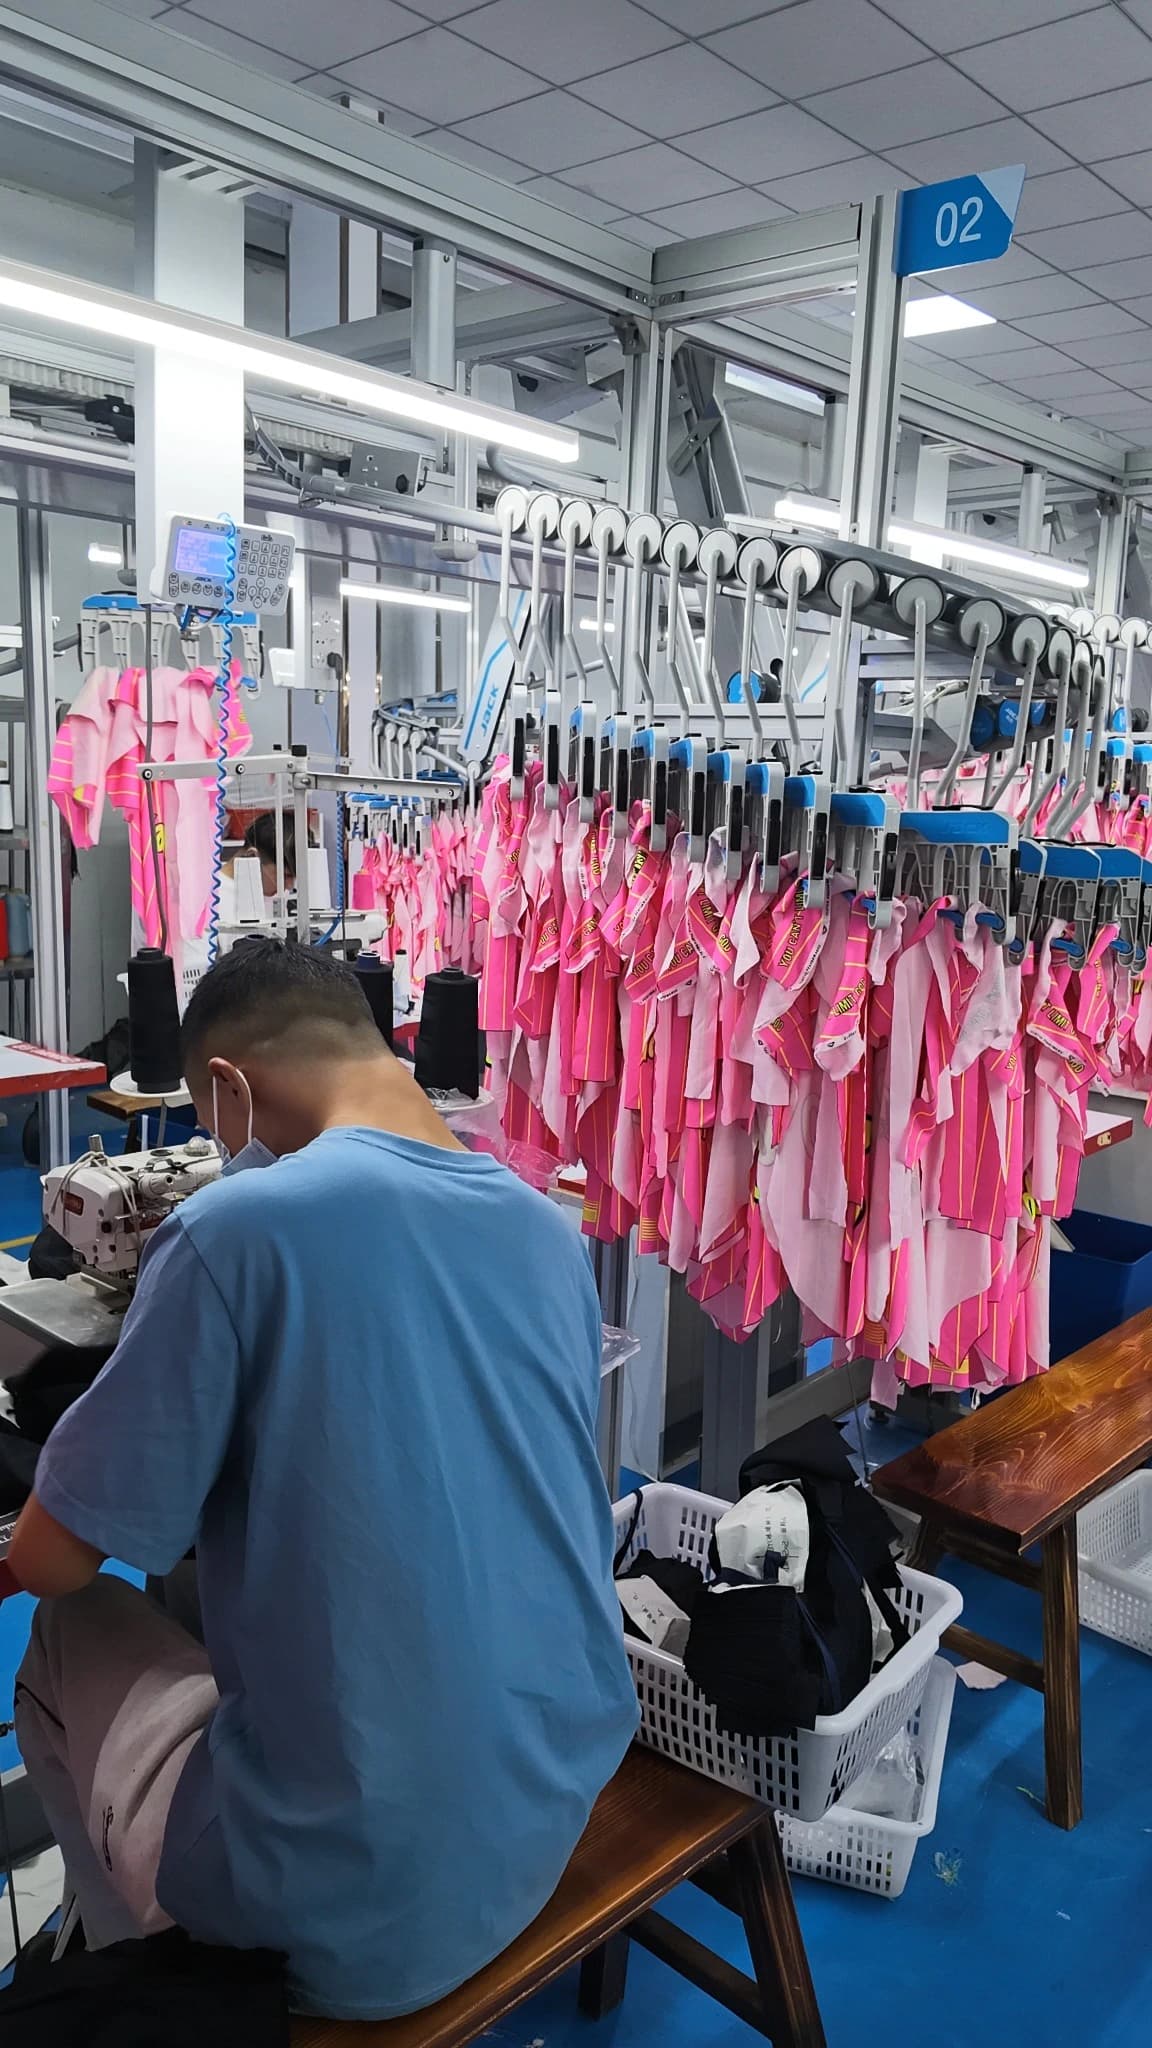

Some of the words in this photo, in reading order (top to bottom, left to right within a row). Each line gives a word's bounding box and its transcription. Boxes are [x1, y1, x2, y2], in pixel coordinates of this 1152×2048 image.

[935, 196, 984, 248] 02
[481, 684, 500, 737] JACK
[632, 953, 649, 978] YOU
[778, 946, 795, 969] YOU
